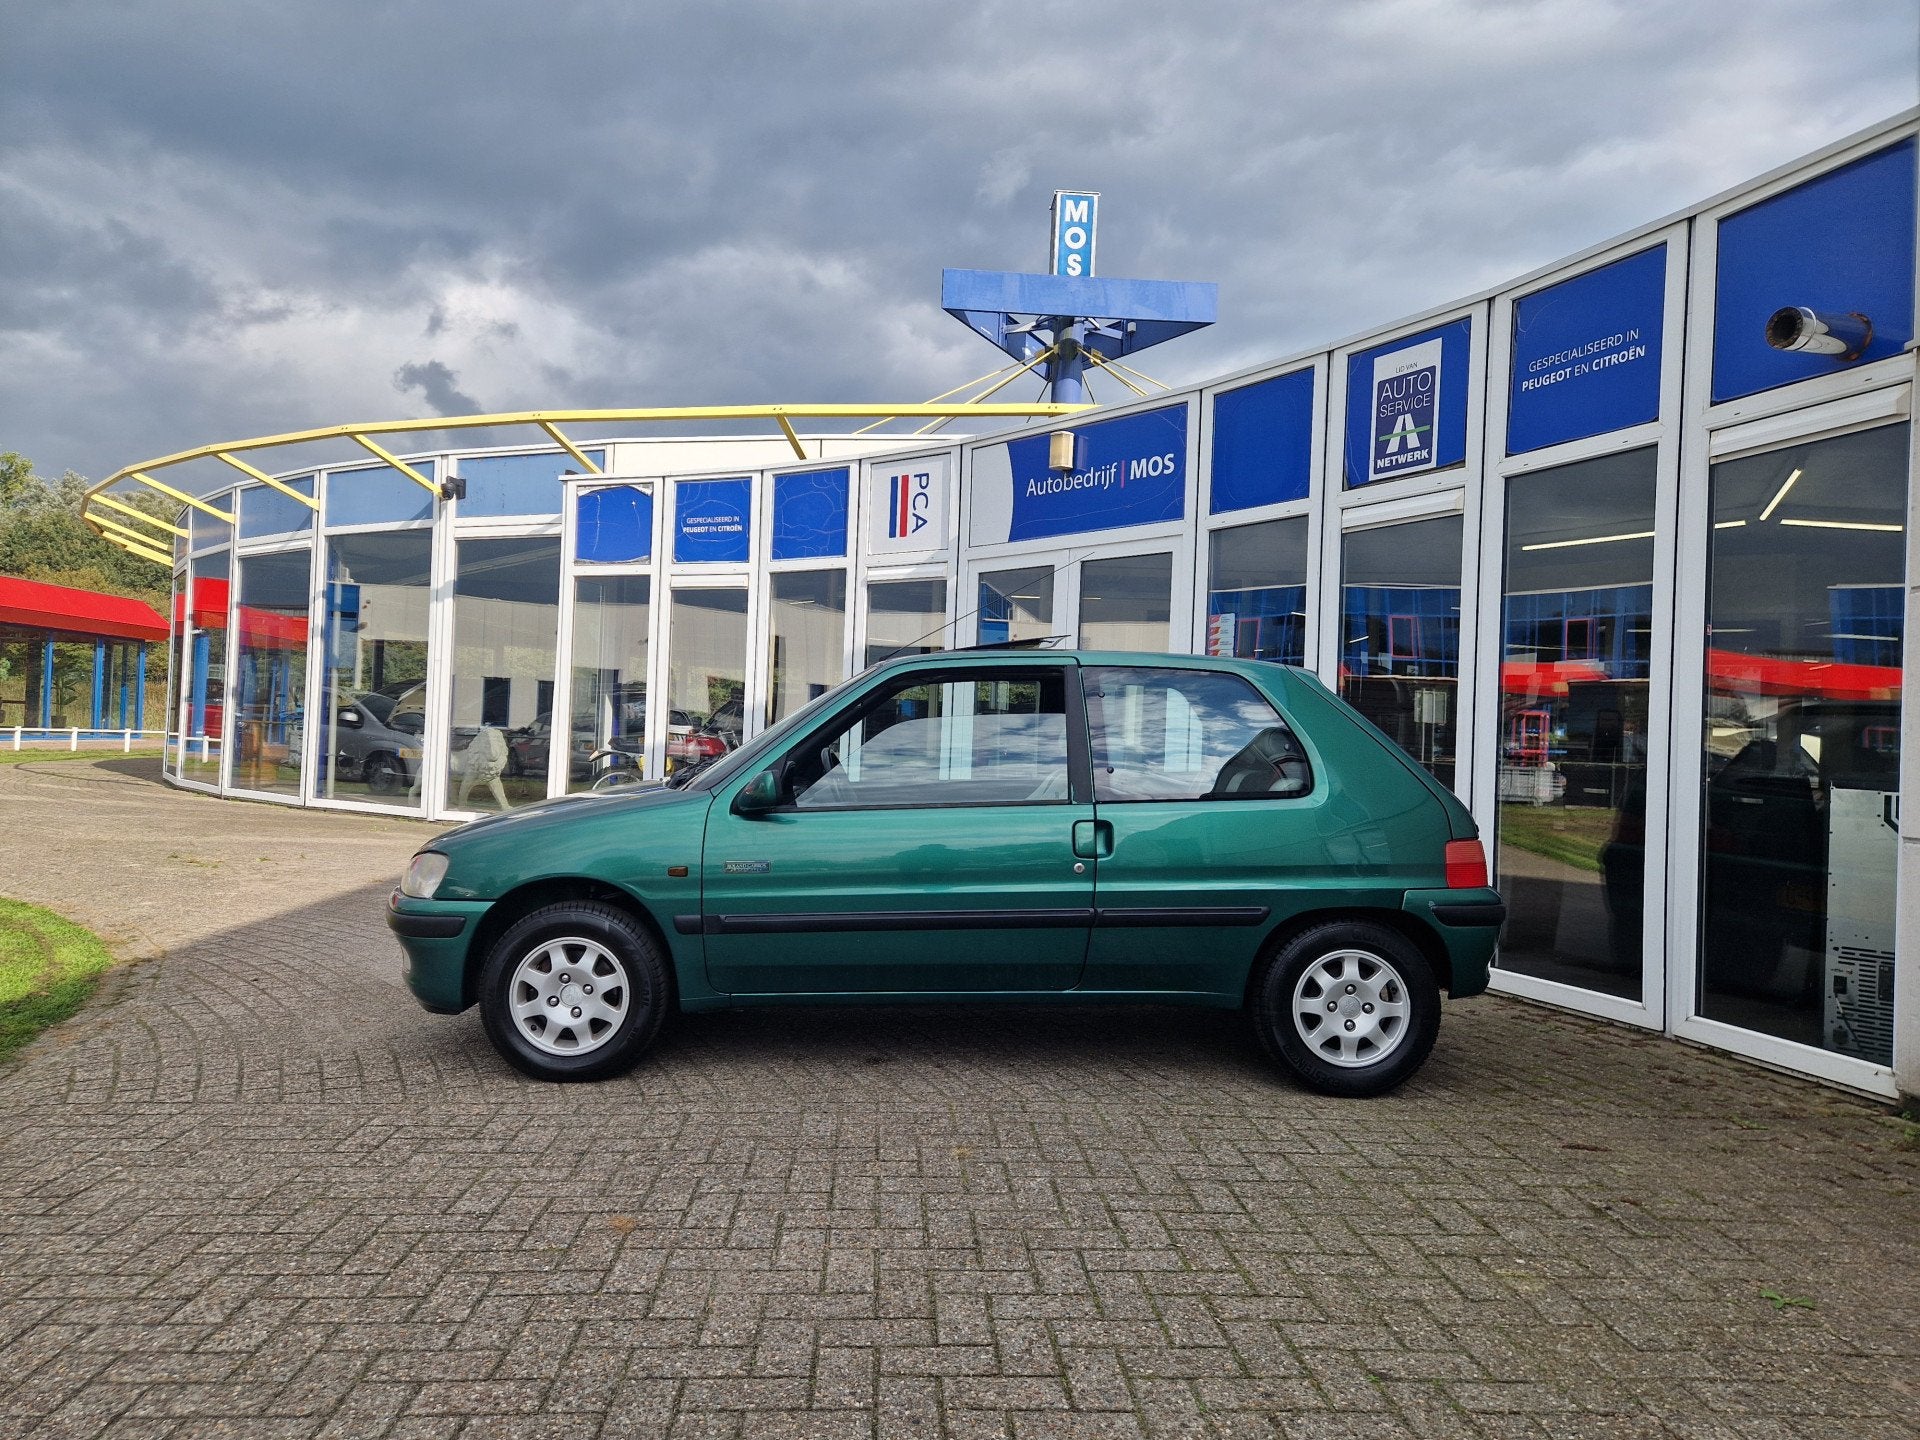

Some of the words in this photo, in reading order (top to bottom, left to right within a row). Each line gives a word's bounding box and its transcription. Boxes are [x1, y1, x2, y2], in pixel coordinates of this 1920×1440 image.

[1065, 199, 1088, 277] MOS
[1528, 333, 1623, 373] GESPECIALISEERD
[1626, 327, 1639, 342] IN
[1405, 362, 1418, 371] VAN
[1521, 367, 1572, 392] PEUGEOT
[1574, 362, 1589, 377] EN
[1592, 344, 1646, 371] CITROËN
[1380, 371, 1432, 402] AUTO
[1379, 392, 1431, 418] SERVICE
[1376, 448, 1430, 469] NETWERK
[1026, 462, 1118, 497] Autobedrijf
[1129, 453, 1175, 480] MOS
[912, 472, 930, 534] PCA
[683, 525, 708, 533] PEUGEOT
[686, 516, 733, 524] GESPECIALISEERD
